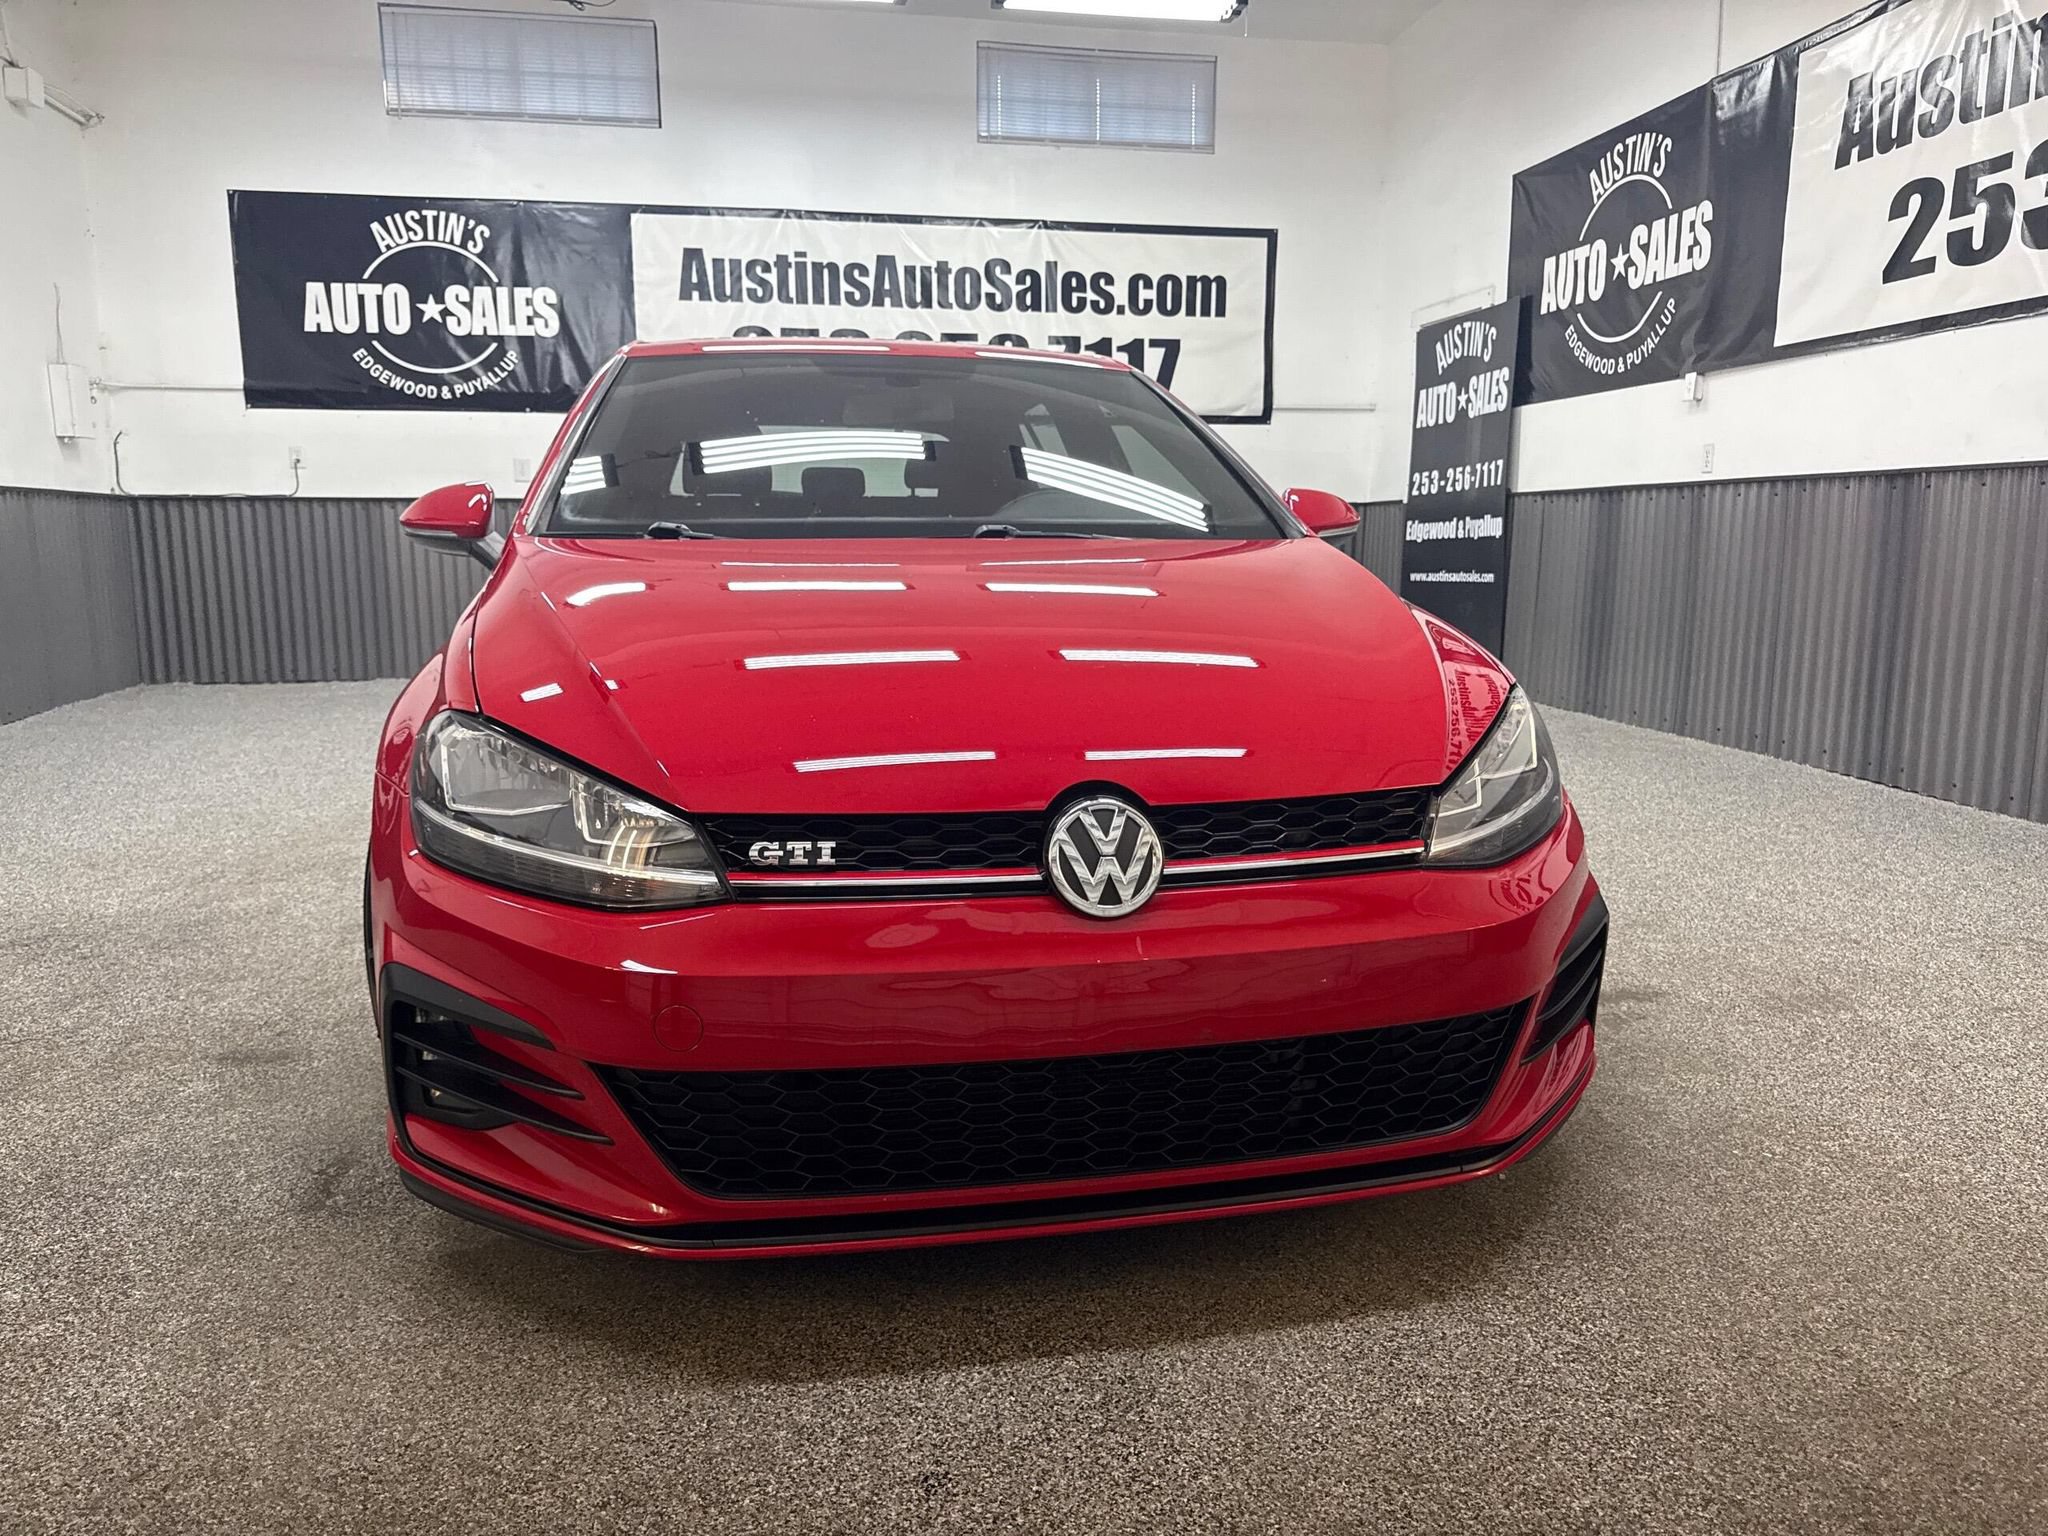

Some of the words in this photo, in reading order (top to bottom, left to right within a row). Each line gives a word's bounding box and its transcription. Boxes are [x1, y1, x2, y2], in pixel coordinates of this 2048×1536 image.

[1589, 132, 1673, 204] AUSTIN'S
[369, 209, 491, 254] AUSTIN'S
[1540, 238, 1607, 315] AUTO
[1627, 199, 1714, 290] SALES
[303, 282, 412, 335] AUTO
[444, 284, 561, 338] SALES
[678, 247, 1227, 318] AustinsAutoSales.com
[1048, 335, 1181, 392] 17
[1435, 321, 1497, 375] AUSTIN'S
[1564, 324, 1616, 375] EDGEWOOD
[1617, 357, 1625, 374] &
[1626, 297, 1677, 370] PUYALLUP
[352, 348, 438, 399] EDGEWOOD
[441, 385, 452, 399] &
[454, 350, 519, 398] PUYALLUP
[1416, 381, 1457, 429] AUTO
[1468, 367, 1510, 419] SALES
[1411, 459, 1504, 496] 253-256-7117
[1405, 517, 1457, 543] Edgewood
[1457, 520, 1465, 539] &
[1465, 513, 1503, 540] Puyallup
[1409, 569, 1495, 583] www.austinsautosales.com
[748, 841, 837, 866] GTI
